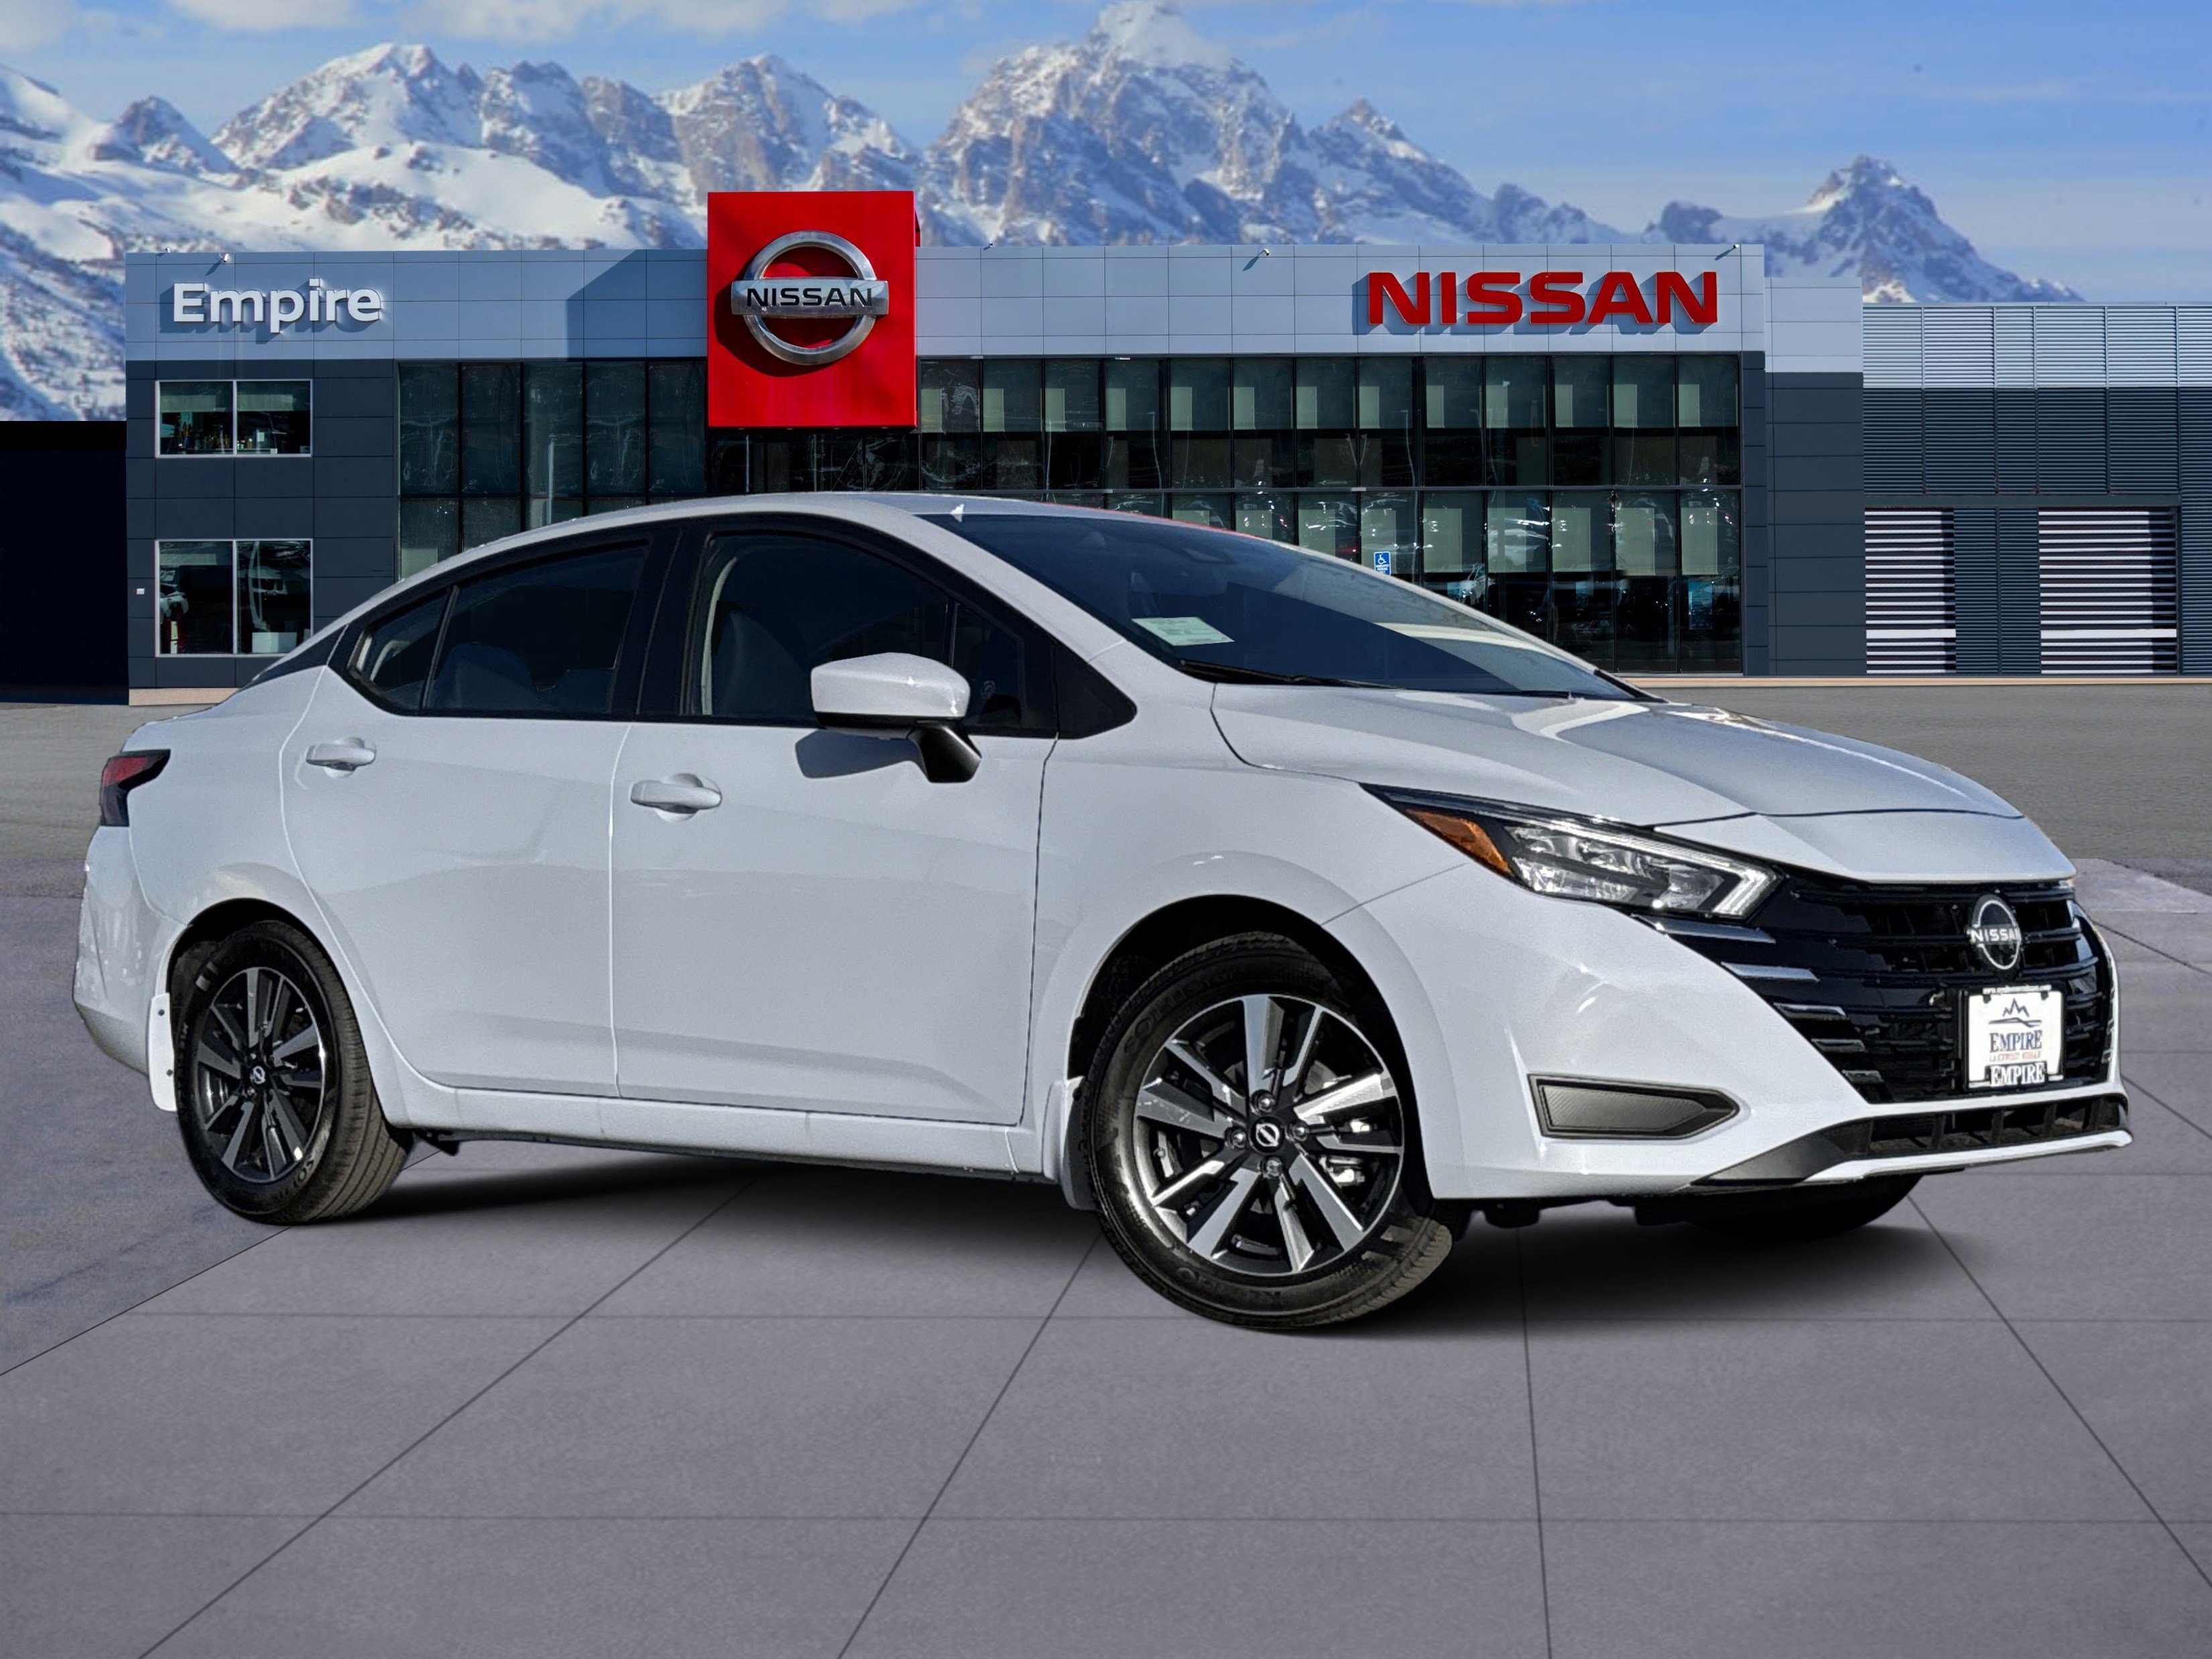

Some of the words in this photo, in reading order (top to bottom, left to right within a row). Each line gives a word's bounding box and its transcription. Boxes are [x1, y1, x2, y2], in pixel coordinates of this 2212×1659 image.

[173, 278, 381, 334] Empire
[747, 288, 872, 307] NISSAN
[1368, 265, 1718, 324] NISSAN
[1989, 1030, 2043, 1053] EMPIRE
[1989, 1062, 2045, 1087] EMPIRE
